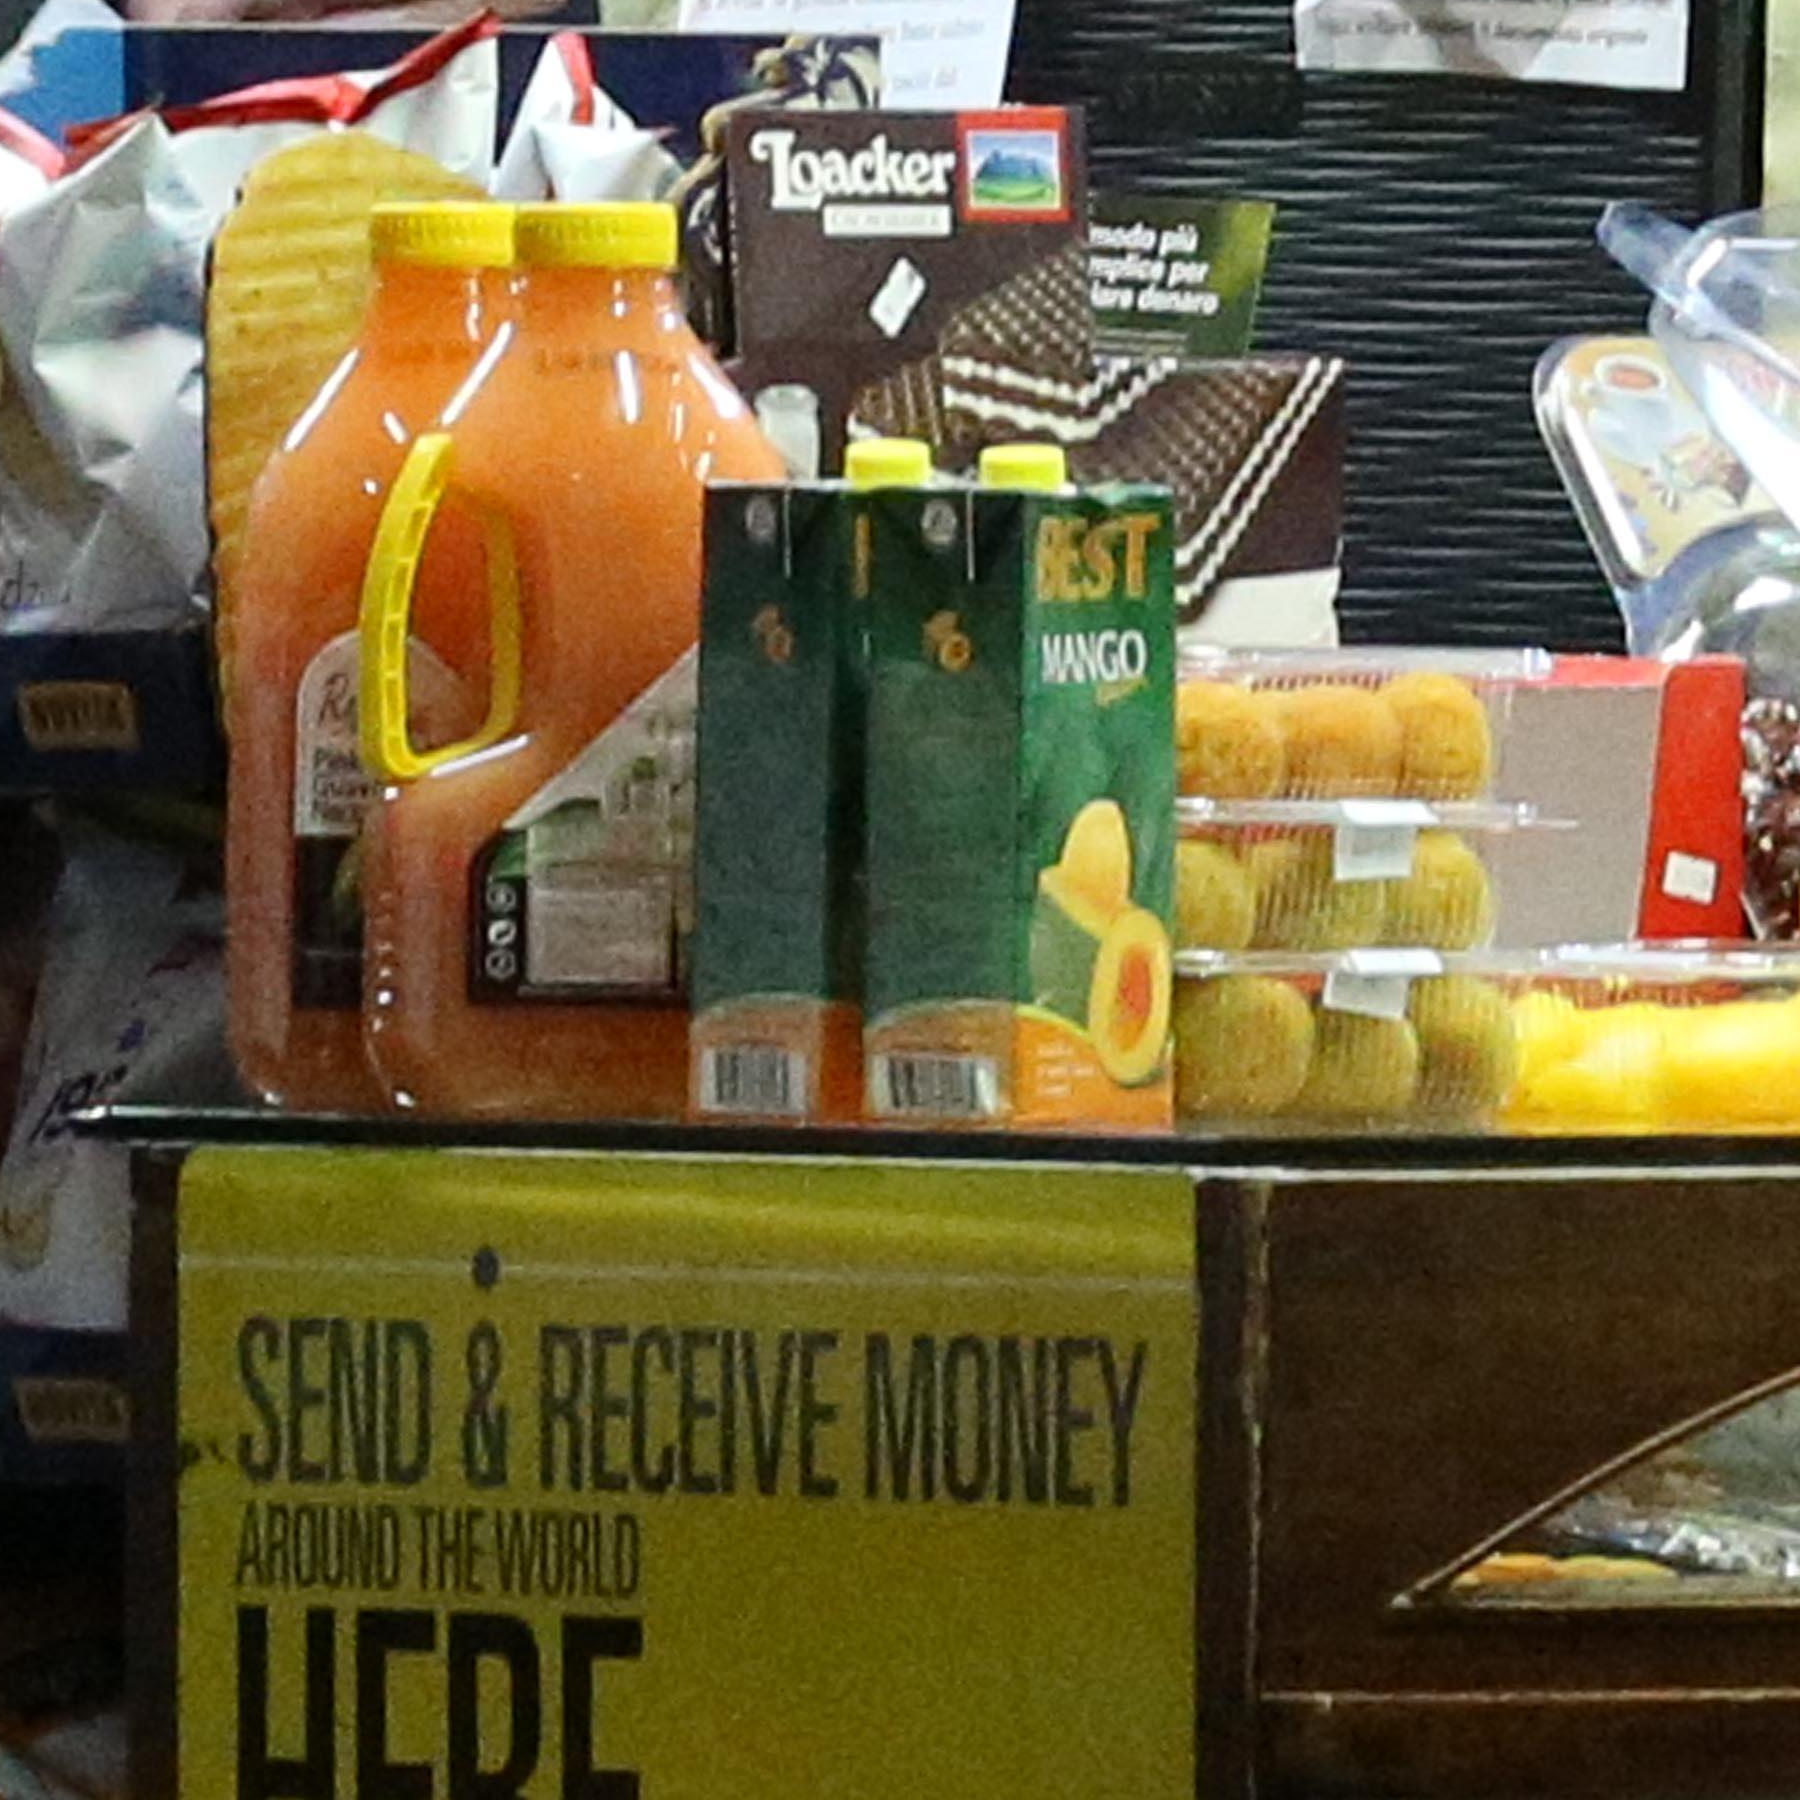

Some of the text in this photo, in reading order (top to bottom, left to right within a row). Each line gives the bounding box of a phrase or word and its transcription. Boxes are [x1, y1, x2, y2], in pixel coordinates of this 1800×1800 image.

[750, 128, 957, 210] Loacker
[1034, 512, 1161, 601] BEST
[1041, 628, 1147, 684] MANGO
[236, 1315, 1148, 1508] SEND & RECEIVE MONEY
[236, 1500, 642, 1600] AROUND THE WORLD
